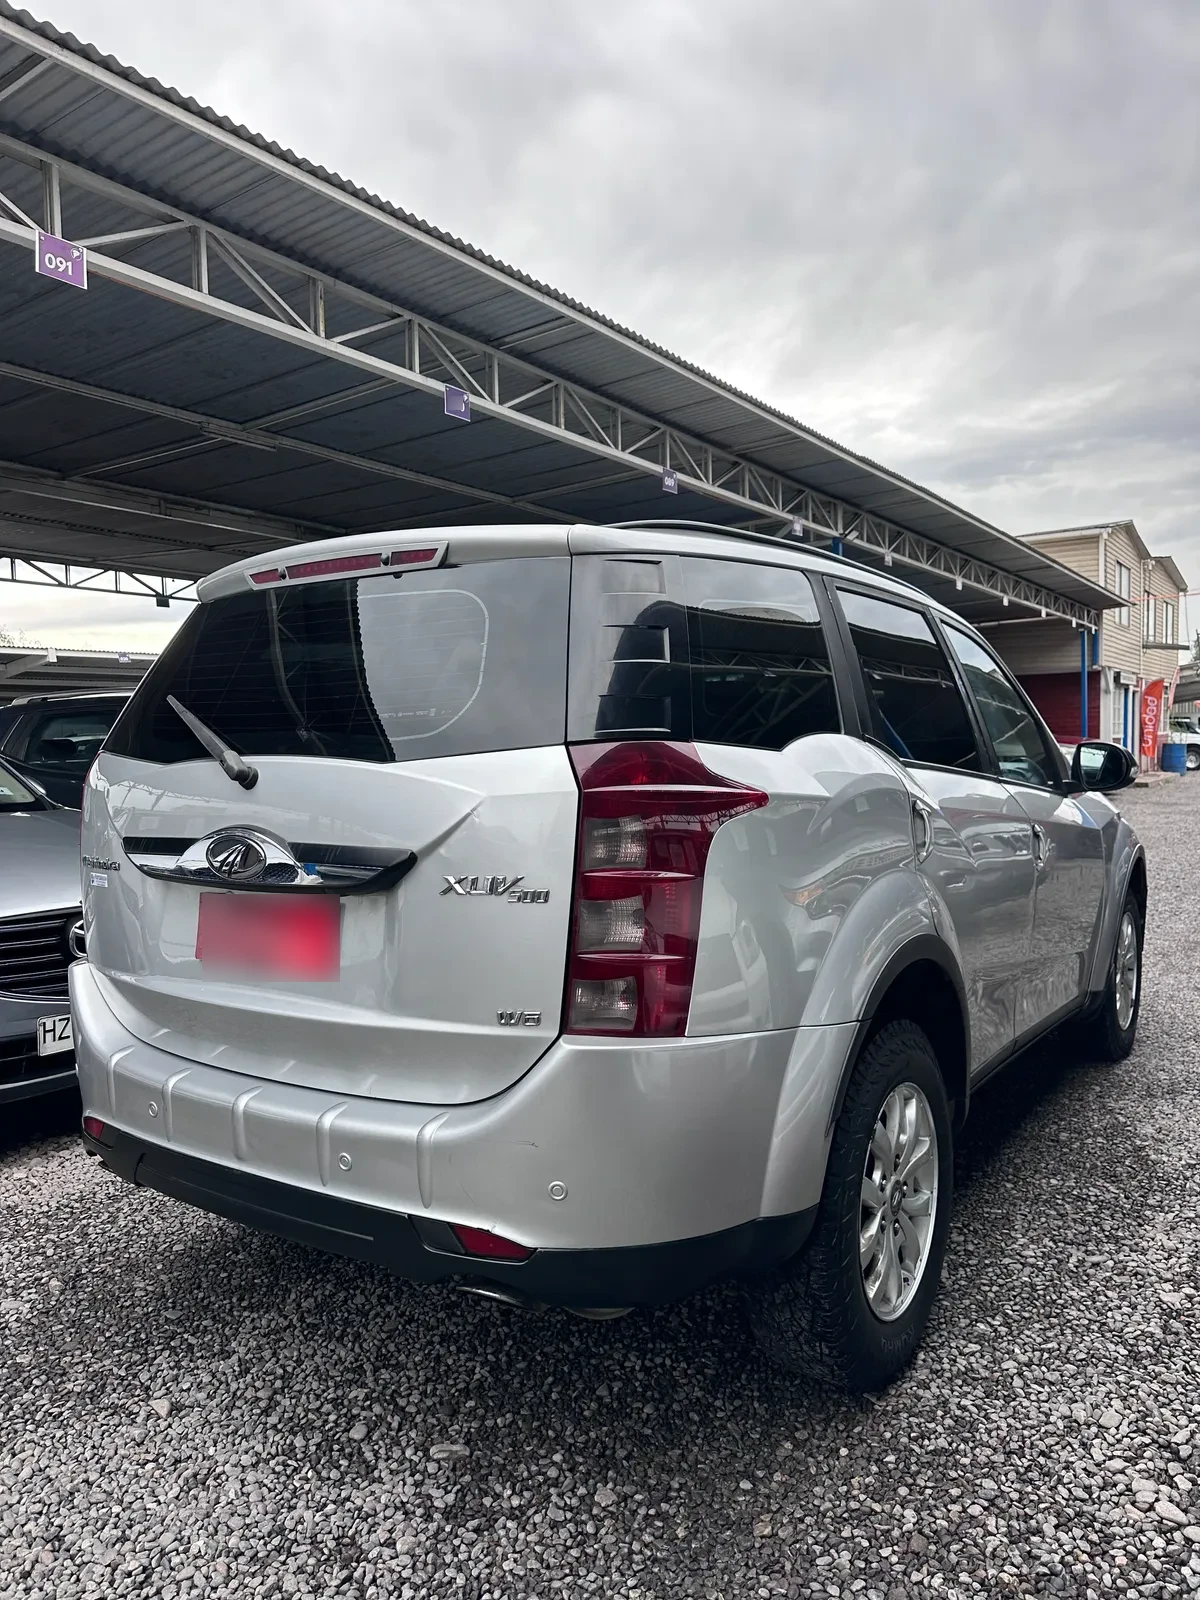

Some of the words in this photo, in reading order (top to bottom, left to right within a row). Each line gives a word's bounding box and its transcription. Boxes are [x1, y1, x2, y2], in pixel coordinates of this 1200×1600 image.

[44, 253, 73, 276] 091
[1142, 695, 1158, 748] unidad
[42, 1017, 71, 1044] HZ
[496, 1010, 541, 1026] W6
